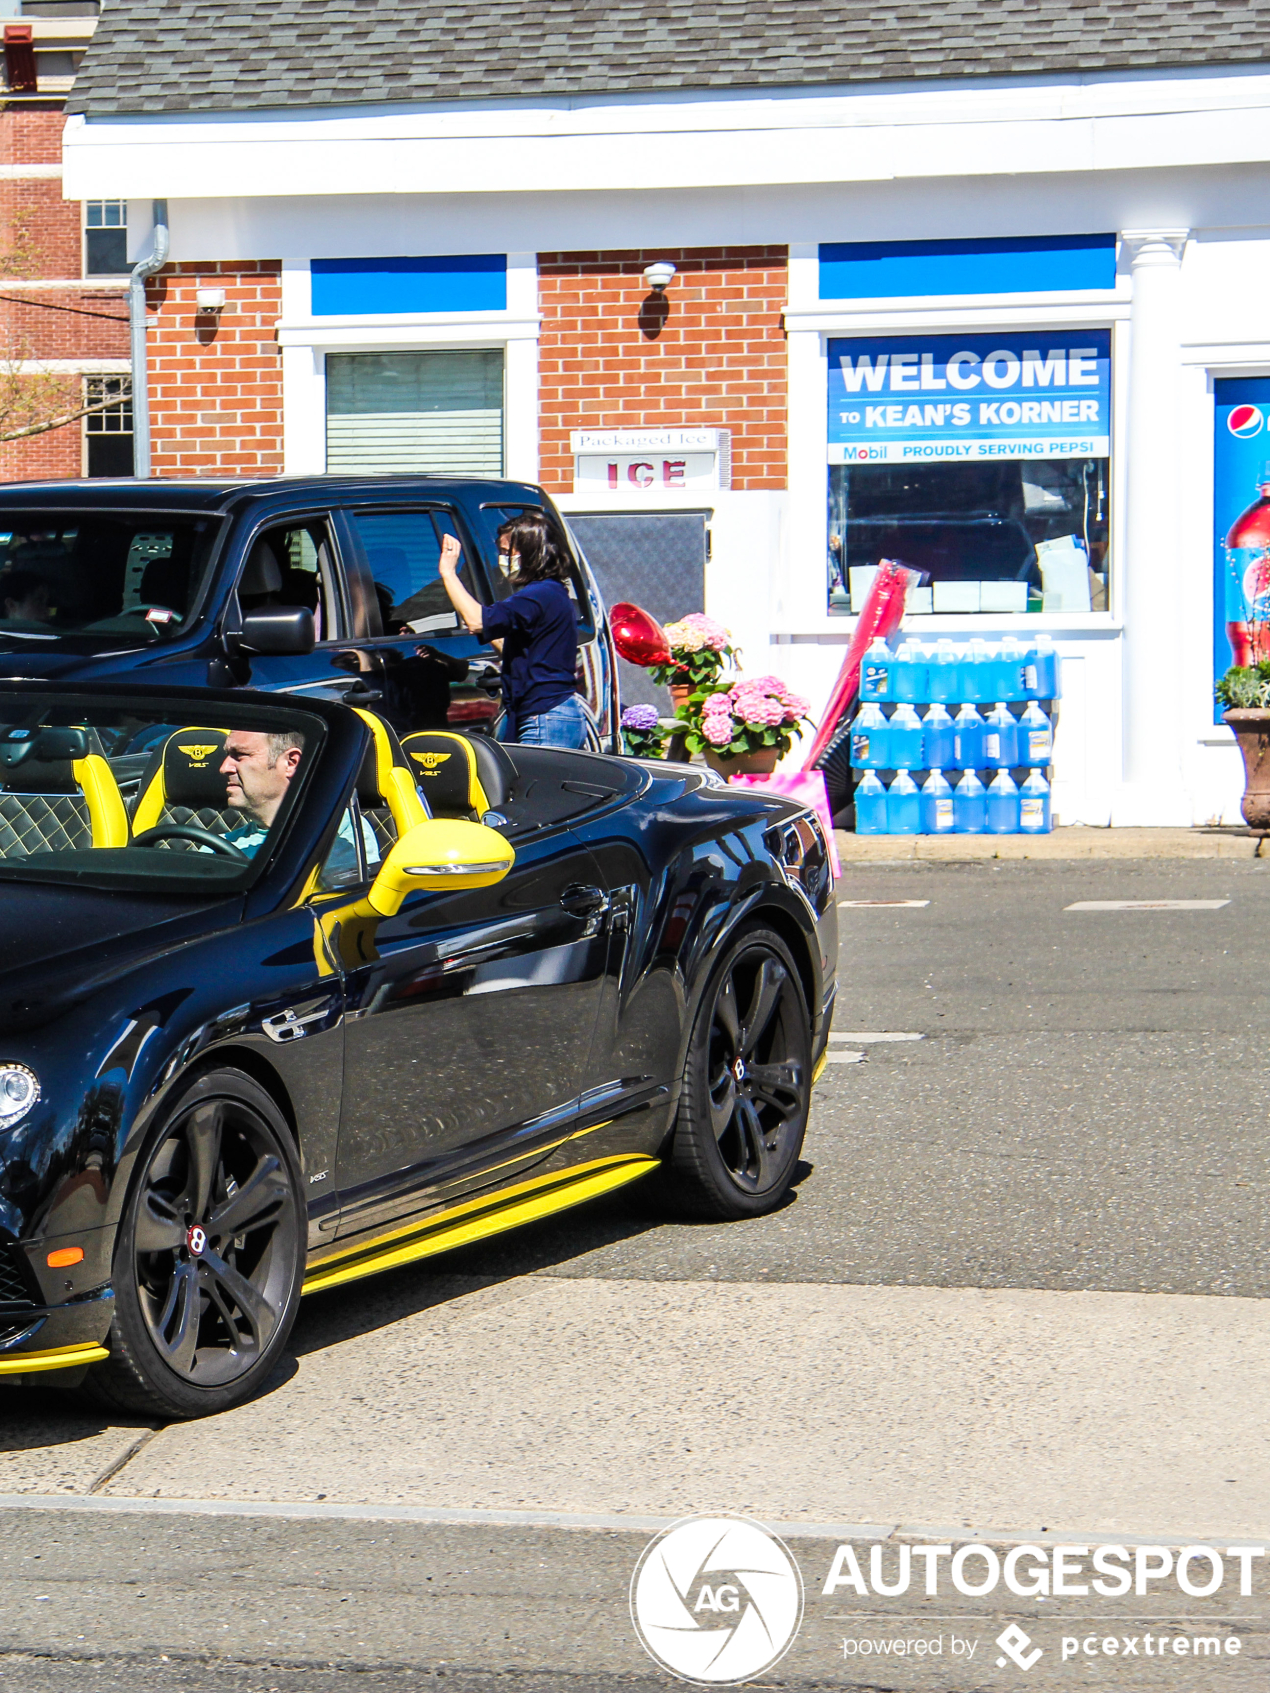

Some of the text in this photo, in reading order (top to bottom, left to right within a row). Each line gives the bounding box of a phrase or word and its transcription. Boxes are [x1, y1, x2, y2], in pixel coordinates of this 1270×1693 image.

[839, 348, 1100, 392] WELCOME
[839, 400, 1100, 428] TO KEAN'S KORNER
[580, 433, 708, 448] Packaged Ice
[843, 442, 1094, 460] Mobil PROUDLY SERVING PEPSI
[606, 457, 686, 489] ICE
